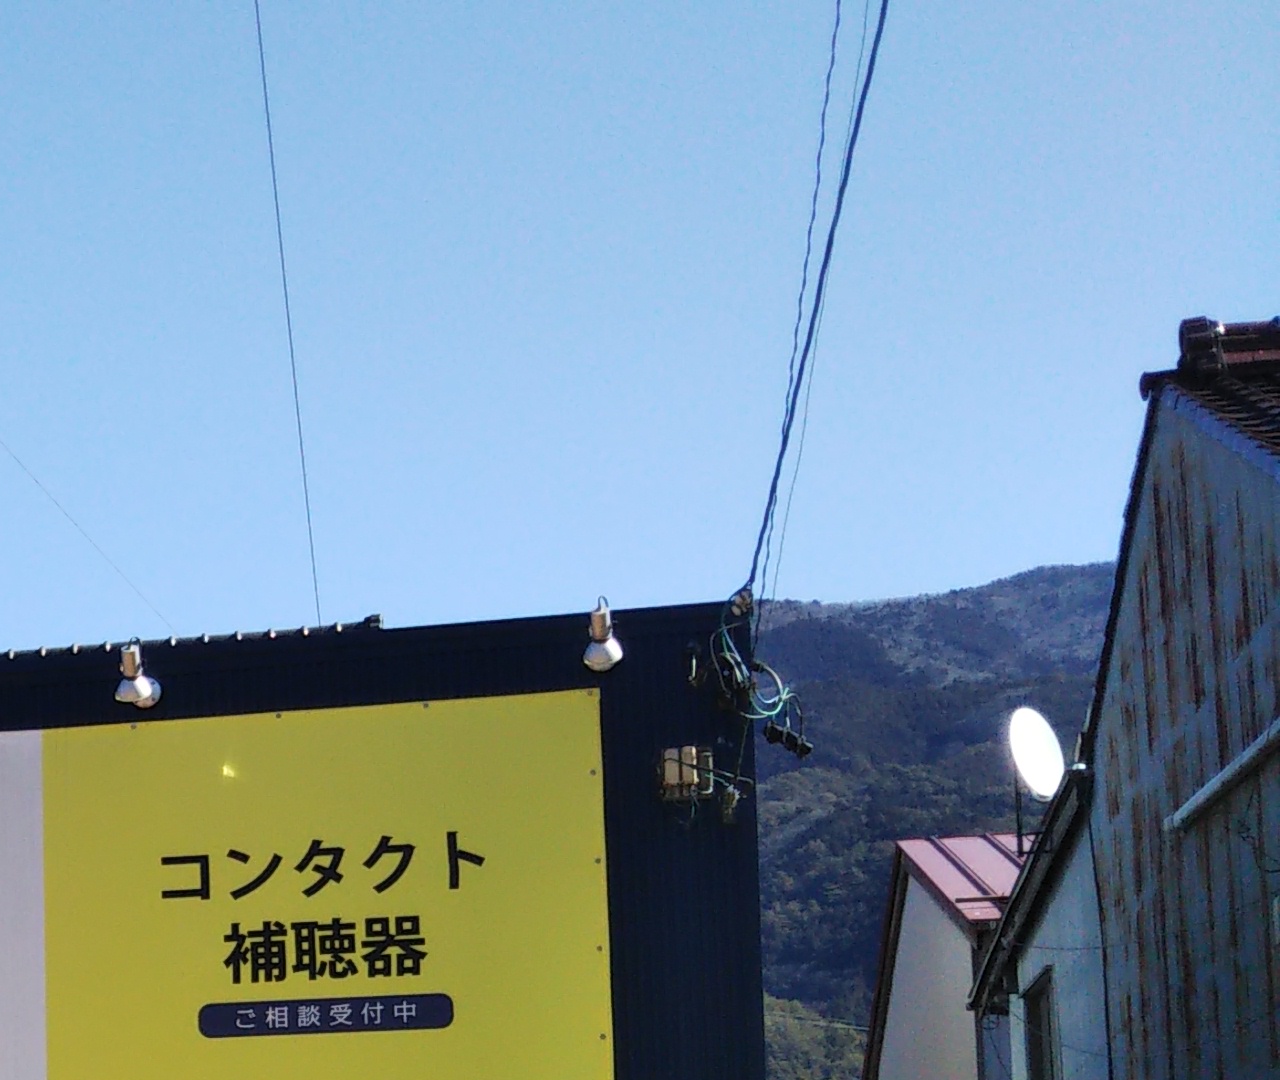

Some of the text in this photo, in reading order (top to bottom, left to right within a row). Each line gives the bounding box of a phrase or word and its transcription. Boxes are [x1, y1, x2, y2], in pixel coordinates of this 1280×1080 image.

[160, 831, 486, 900] コンタクト
[223, 916, 428, 984] 補聴器
[235, 1001, 418, 1030] ご相談受付中
